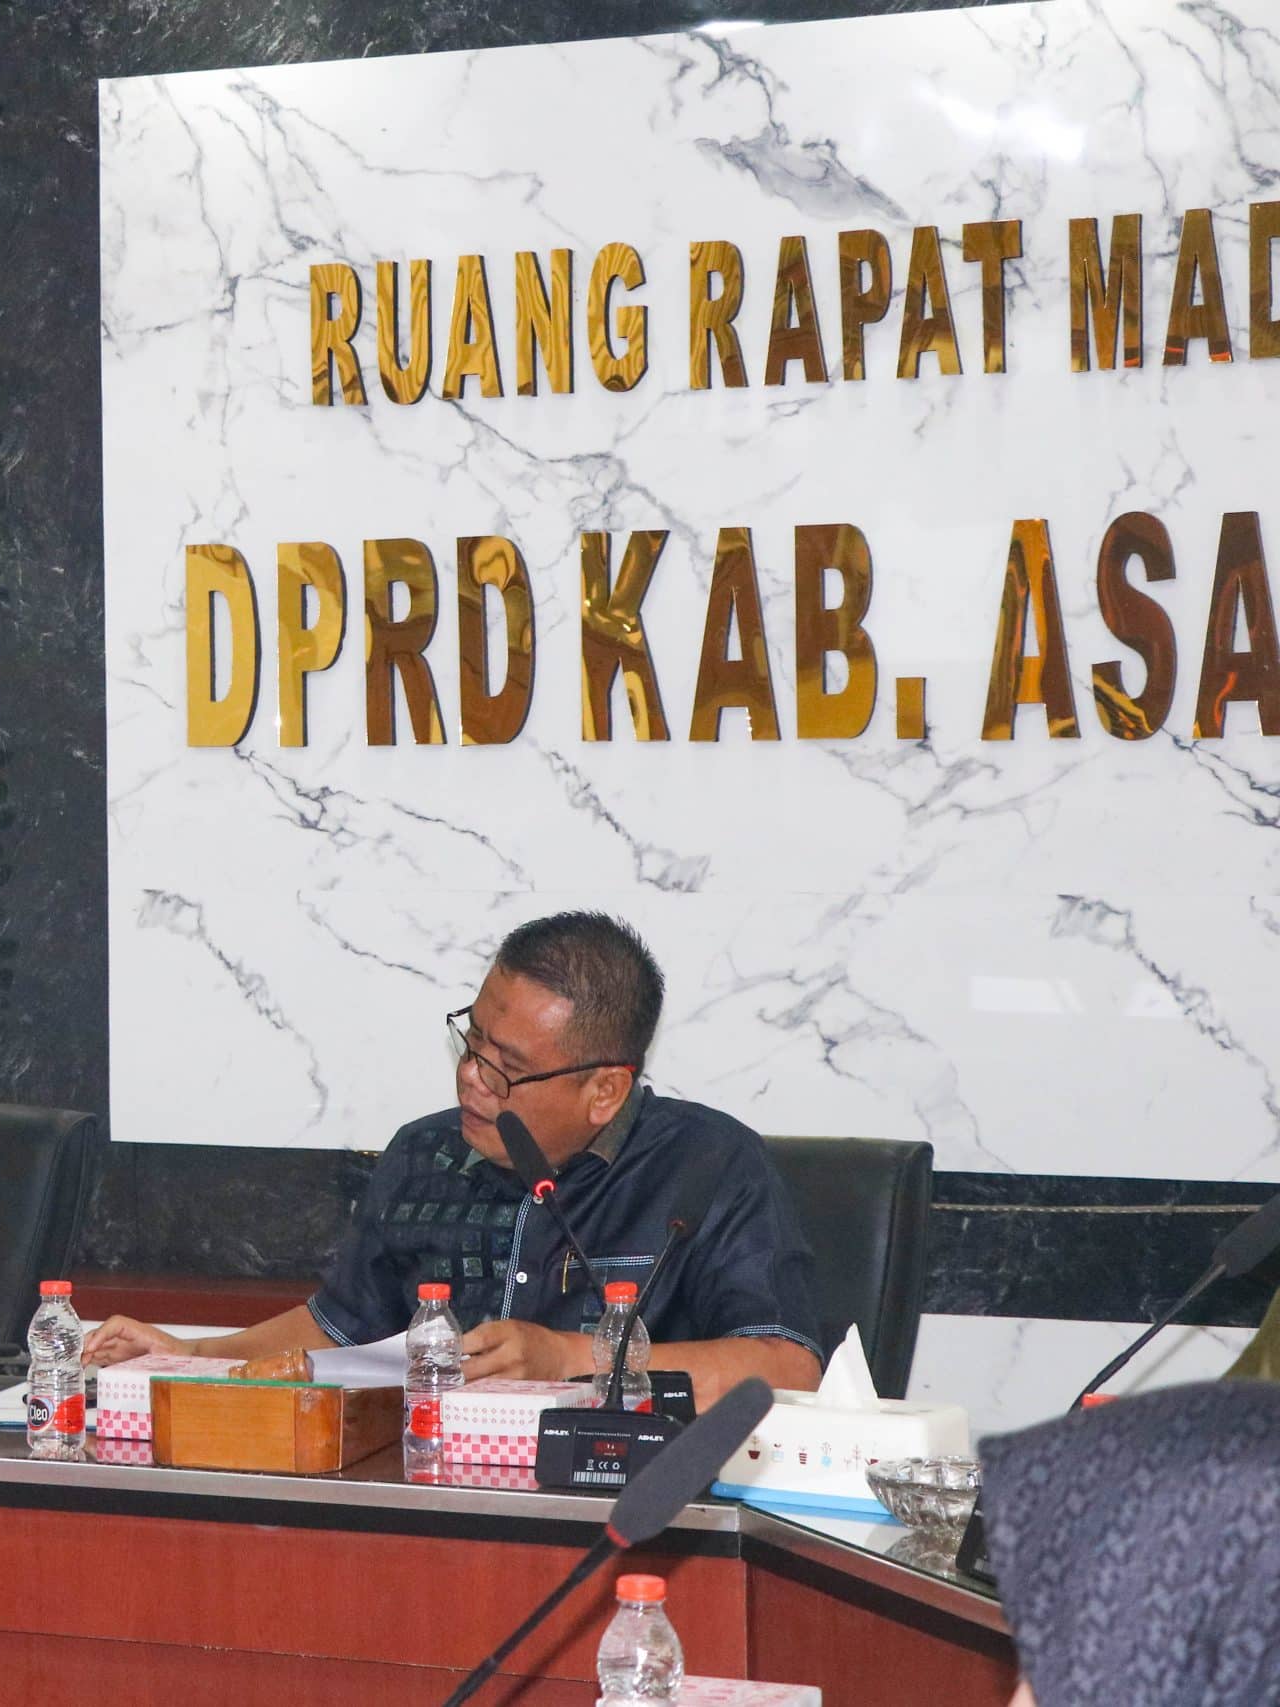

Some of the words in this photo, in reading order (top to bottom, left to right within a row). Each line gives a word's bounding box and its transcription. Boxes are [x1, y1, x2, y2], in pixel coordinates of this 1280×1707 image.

[309, 242, 648, 406] RUANG
[689, 220, 1024, 390] RAPAT
[186, 535, 535, 747] DPRD
[581, 524, 927, 742] KAB.
[981, 511, 1280, 742] ASA
[30, 1403, 48, 1421] Cleo
